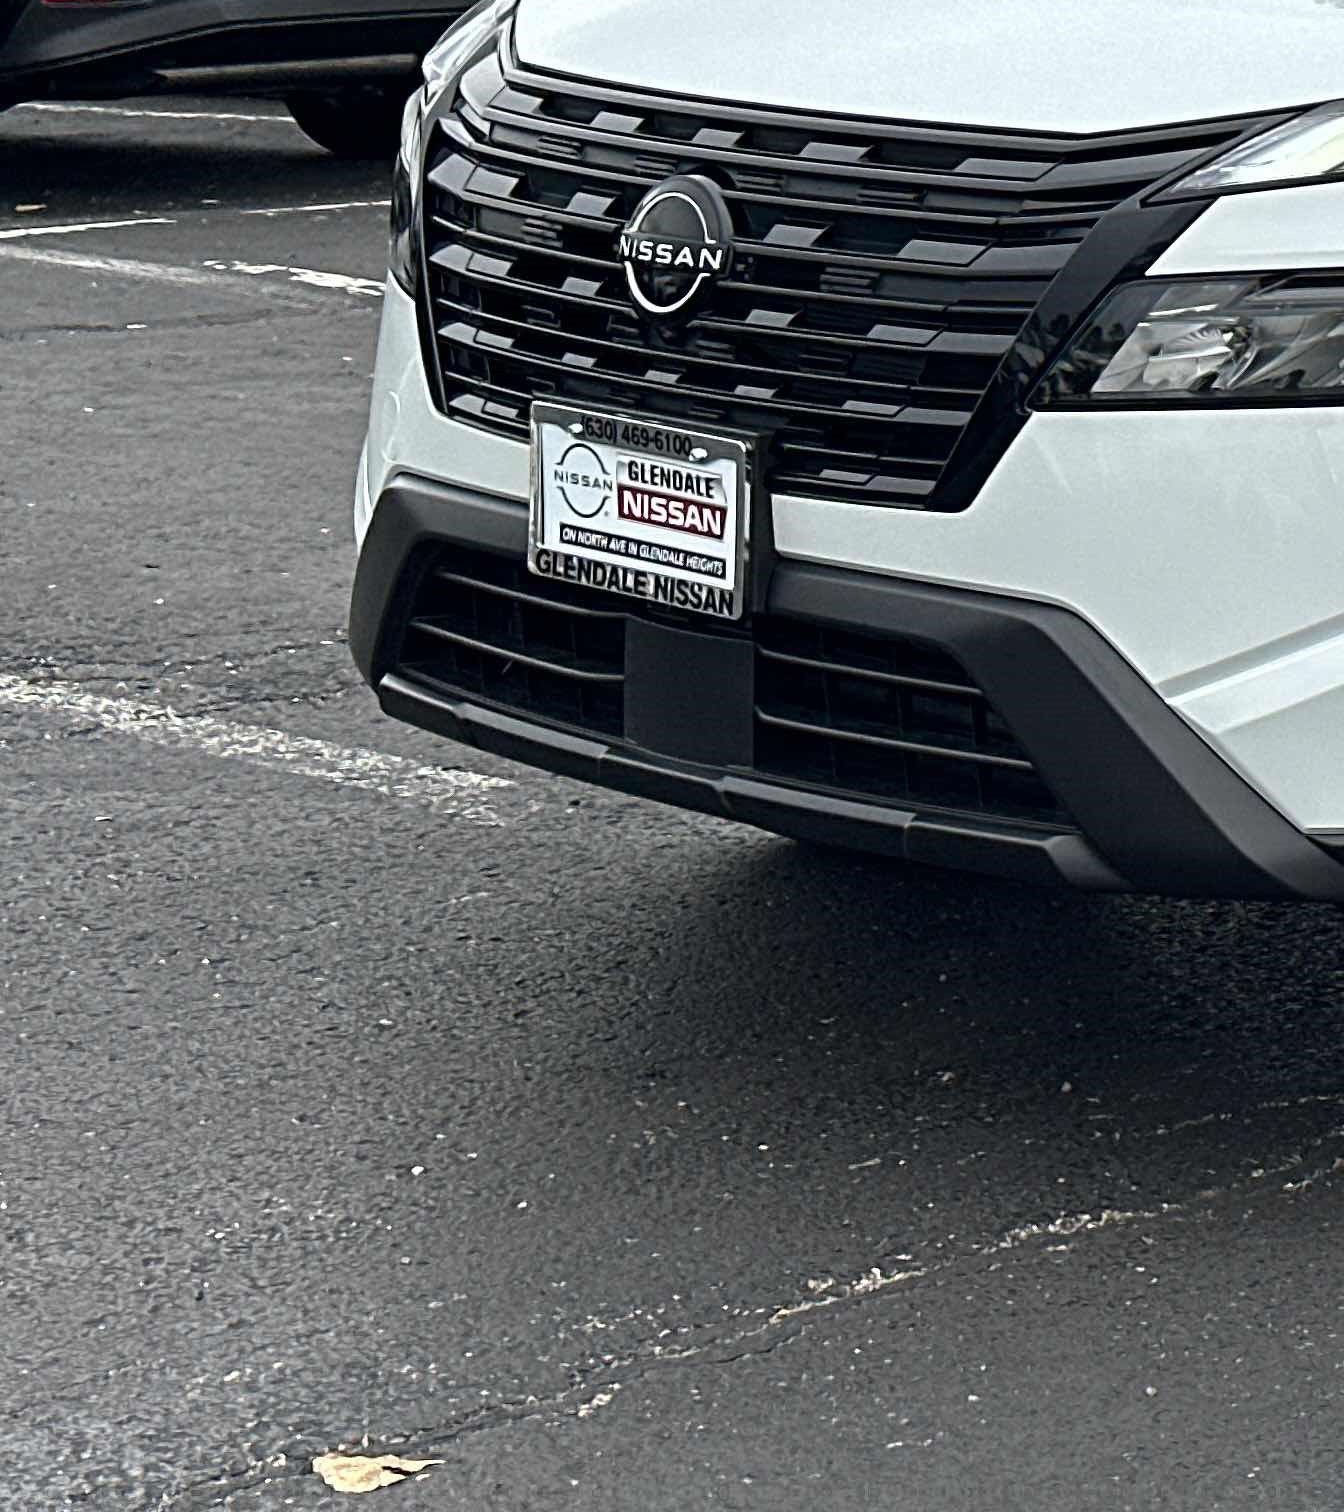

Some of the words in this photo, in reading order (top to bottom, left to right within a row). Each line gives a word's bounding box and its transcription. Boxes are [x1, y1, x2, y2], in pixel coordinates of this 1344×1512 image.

[618, 234, 723, 270] NISSAN
[580, 414, 617, 443] (630)
[621, 423, 692, 456] 469-6100
[554, 469, 613, 492] NISSAN
[627, 459, 716, 499] GLENDALE
[623, 491, 721, 536] NISSAN
[562, 528, 577, 542] ON
[578, 530, 608, 548] NORTH
[609, 538, 627, 553] AVE
[628, 542, 638, 555] IN
[639, 544, 685, 566] GLENDALE
[686, 555, 724, 576] HEIGHTS
[535, 548, 650, 597] GLENDALE
[654, 574, 734, 617] NISSAN
